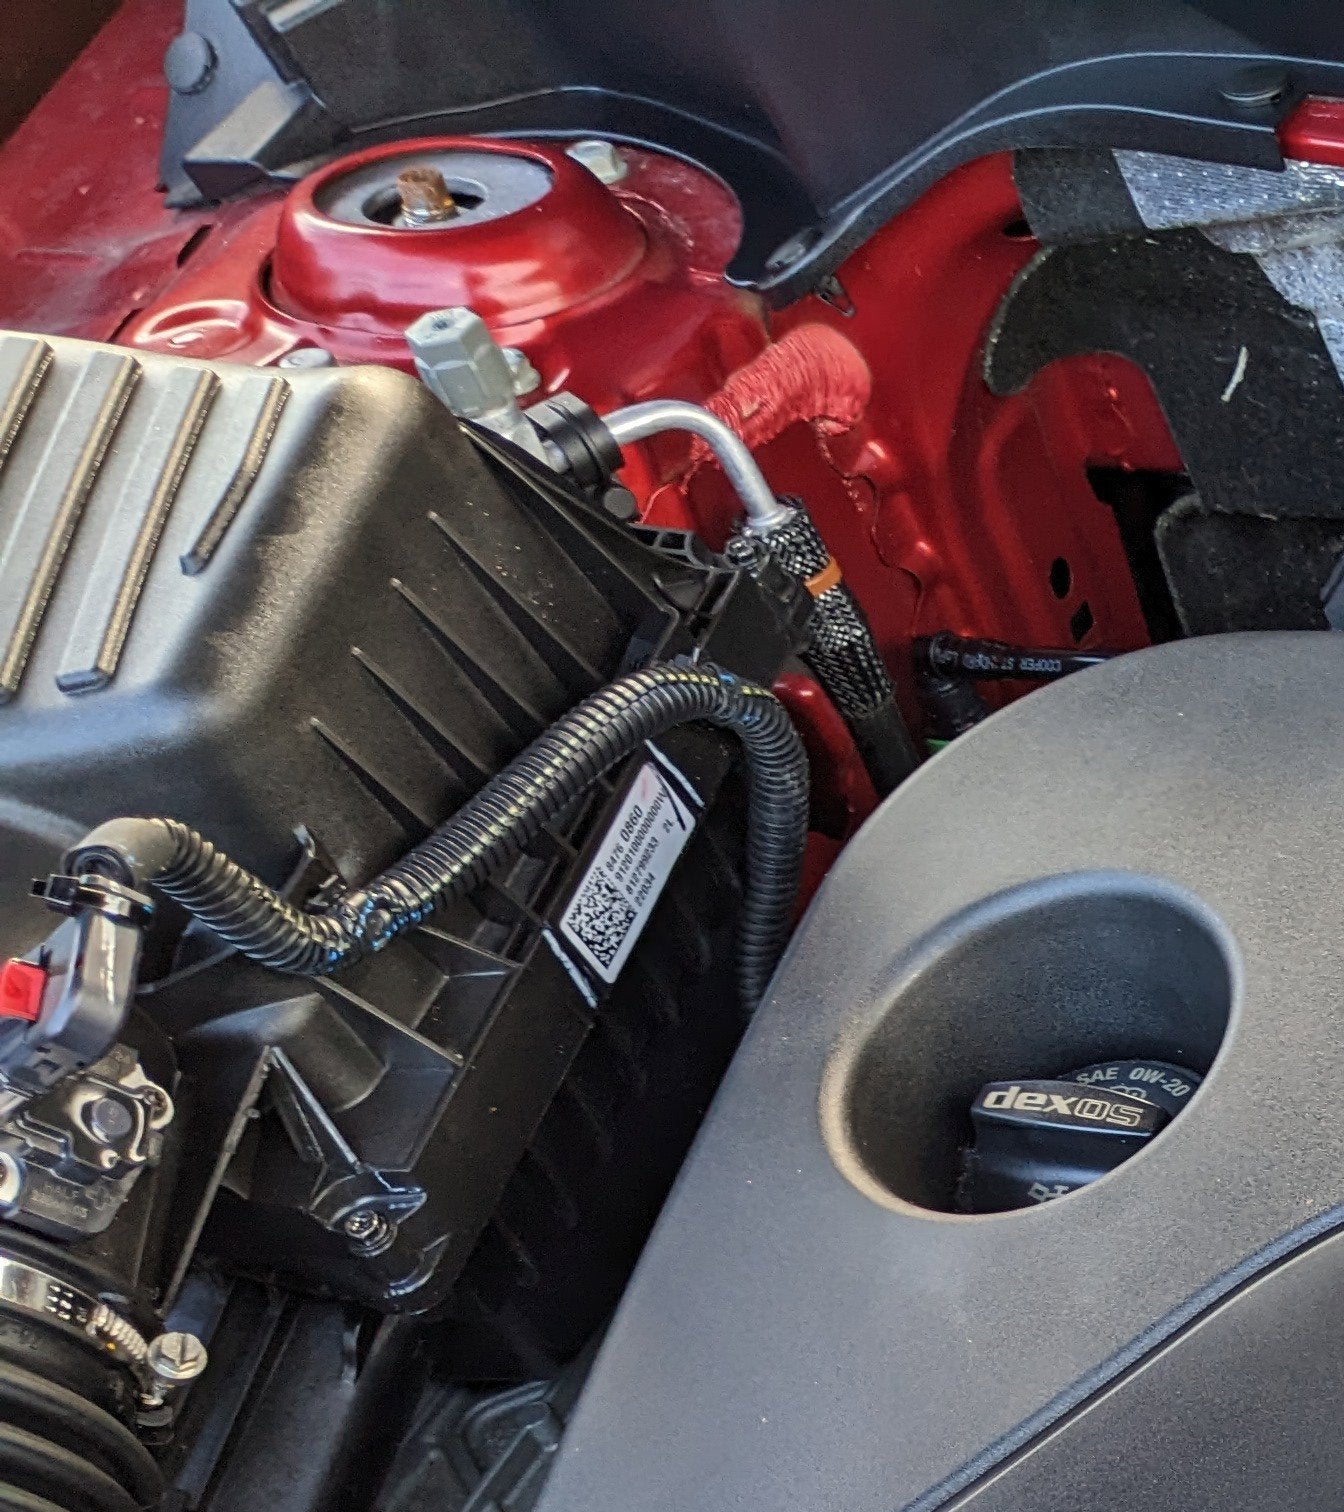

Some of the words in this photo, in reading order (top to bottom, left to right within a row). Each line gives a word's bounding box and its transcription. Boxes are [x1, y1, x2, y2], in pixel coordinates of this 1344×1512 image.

[620, 804, 644, 843] 0860
[1076, 1066, 1120, 1086] SAE
[1128, 1066, 1191, 1098] 0W-20
[981, 1085, 1145, 1127] dexos
